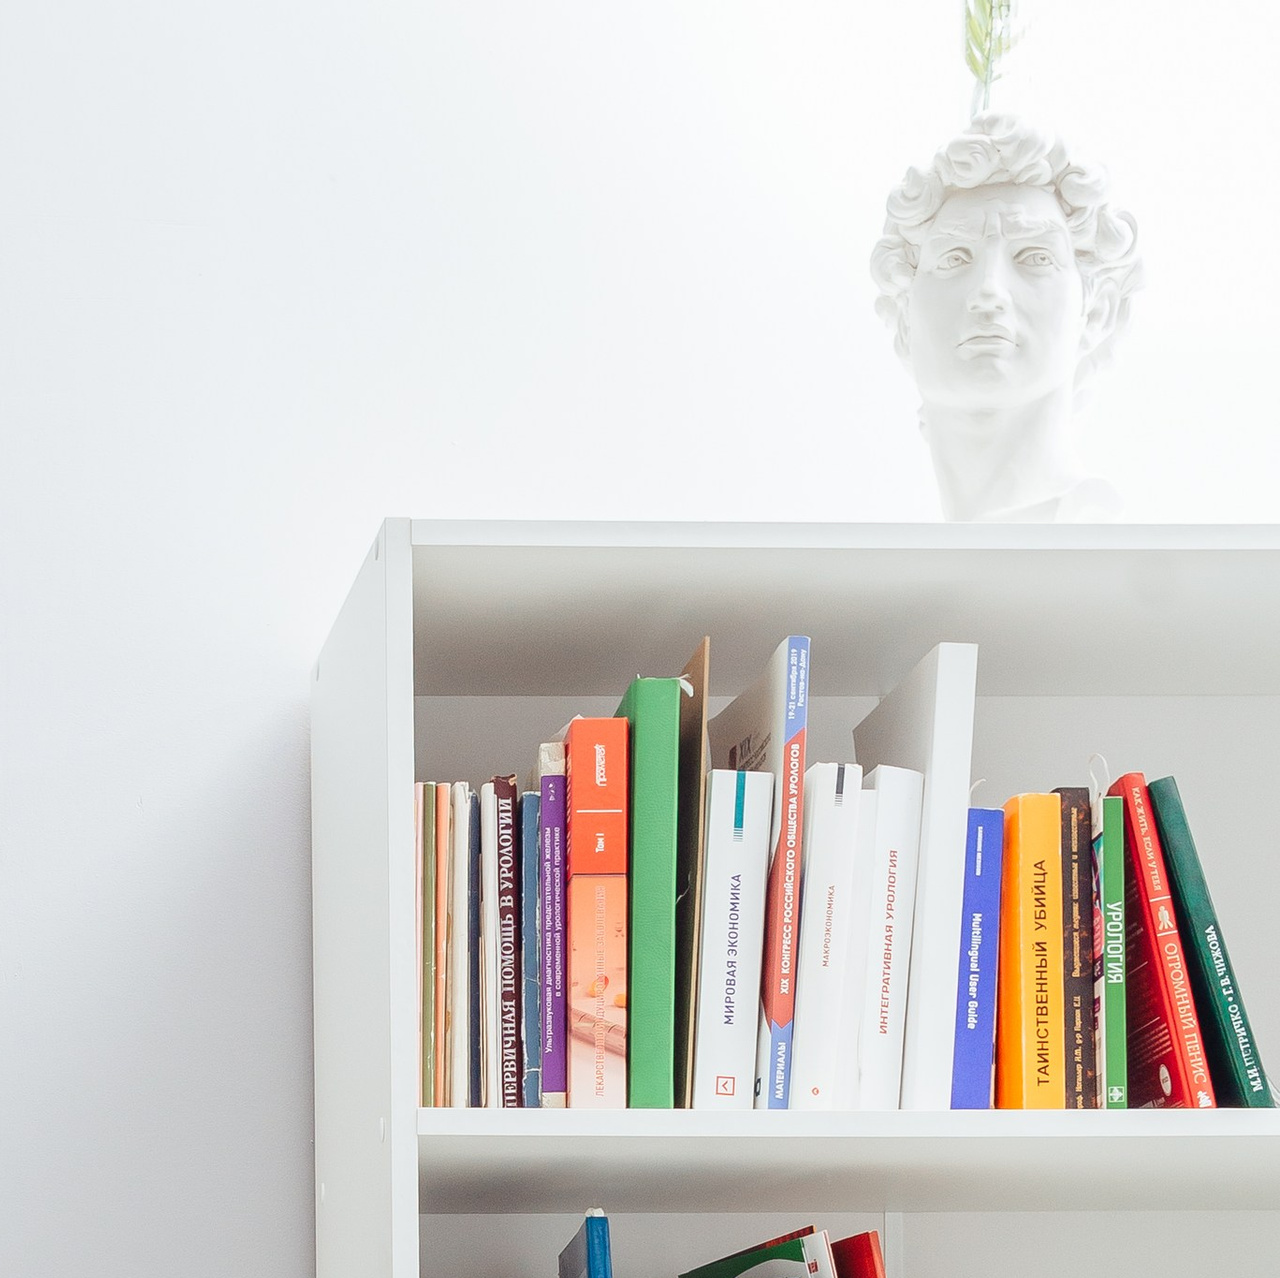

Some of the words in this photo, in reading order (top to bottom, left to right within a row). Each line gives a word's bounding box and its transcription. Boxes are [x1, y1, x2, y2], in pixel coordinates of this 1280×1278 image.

[789, 743, 800, 795] УРОЛОГОВ
[498, 797, 514, 890] УРОЛОГИИ
[554, 827, 562, 866] практике
[595, 837, 605, 853] Том
[786, 796, 798, 849] ОБЩЕСТВА
[1132, 786, 1143, 805] КАК
[1143, 836, 1155, 860] ЕСЛИ
[1150, 868, 1162, 892] ТЕБЯ
[500, 895, 514, 908] В
[544, 861, 553, 930] предстательной
[553, 867, 562, 931] урологической
[729, 873, 742, 957] ЭКОНОМИКА
[783, 850, 796, 924] РОССИЙСКОГО
[1031, 859, 1048, 931] УБИЙЦА
[501, 914, 517, 993] ПОМОЩЬ
[781, 925, 793, 974] КОНГРЕСС
[822, 885, 836, 968] МАКРОЭКОНОМИКА
[879, 925, 893, 1034] ИНТЕГРАТИВНАЯ
[886, 850, 898, 921] УРОЛОГИЯ
[967, 913, 983, 972] Multilingual
[1107, 902, 1124, 984] УРОЛОГИЯ
[1205, 924, 1226, 976] ЧИЖОВА
[545, 932, 553, 986] диагностика
[554, 932, 562, 990] современной
[780, 977, 789, 995] XIX
[969, 973, 980, 999] User
[545, 987, 553, 1053] Ультразвуковая
[724, 961, 737, 1026] МИРОВАЯ
[966, 1001, 978, 1030] Guide
[1032, 941, 1050, 1087] ТАИНСТВЕННЫЙ
[1164, 942, 1197, 1030] ОГРОМНЫЙ
[1185, 1031, 1207, 1085] ПЕНИС
[502, 1000, 518, 1108] ПЕРВИЧНАЯ
[1228, 1004, 1254, 1066] ПЕТРИЧКО
[775, 1042, 787, 1100] МАТЕРИАЛЫ
